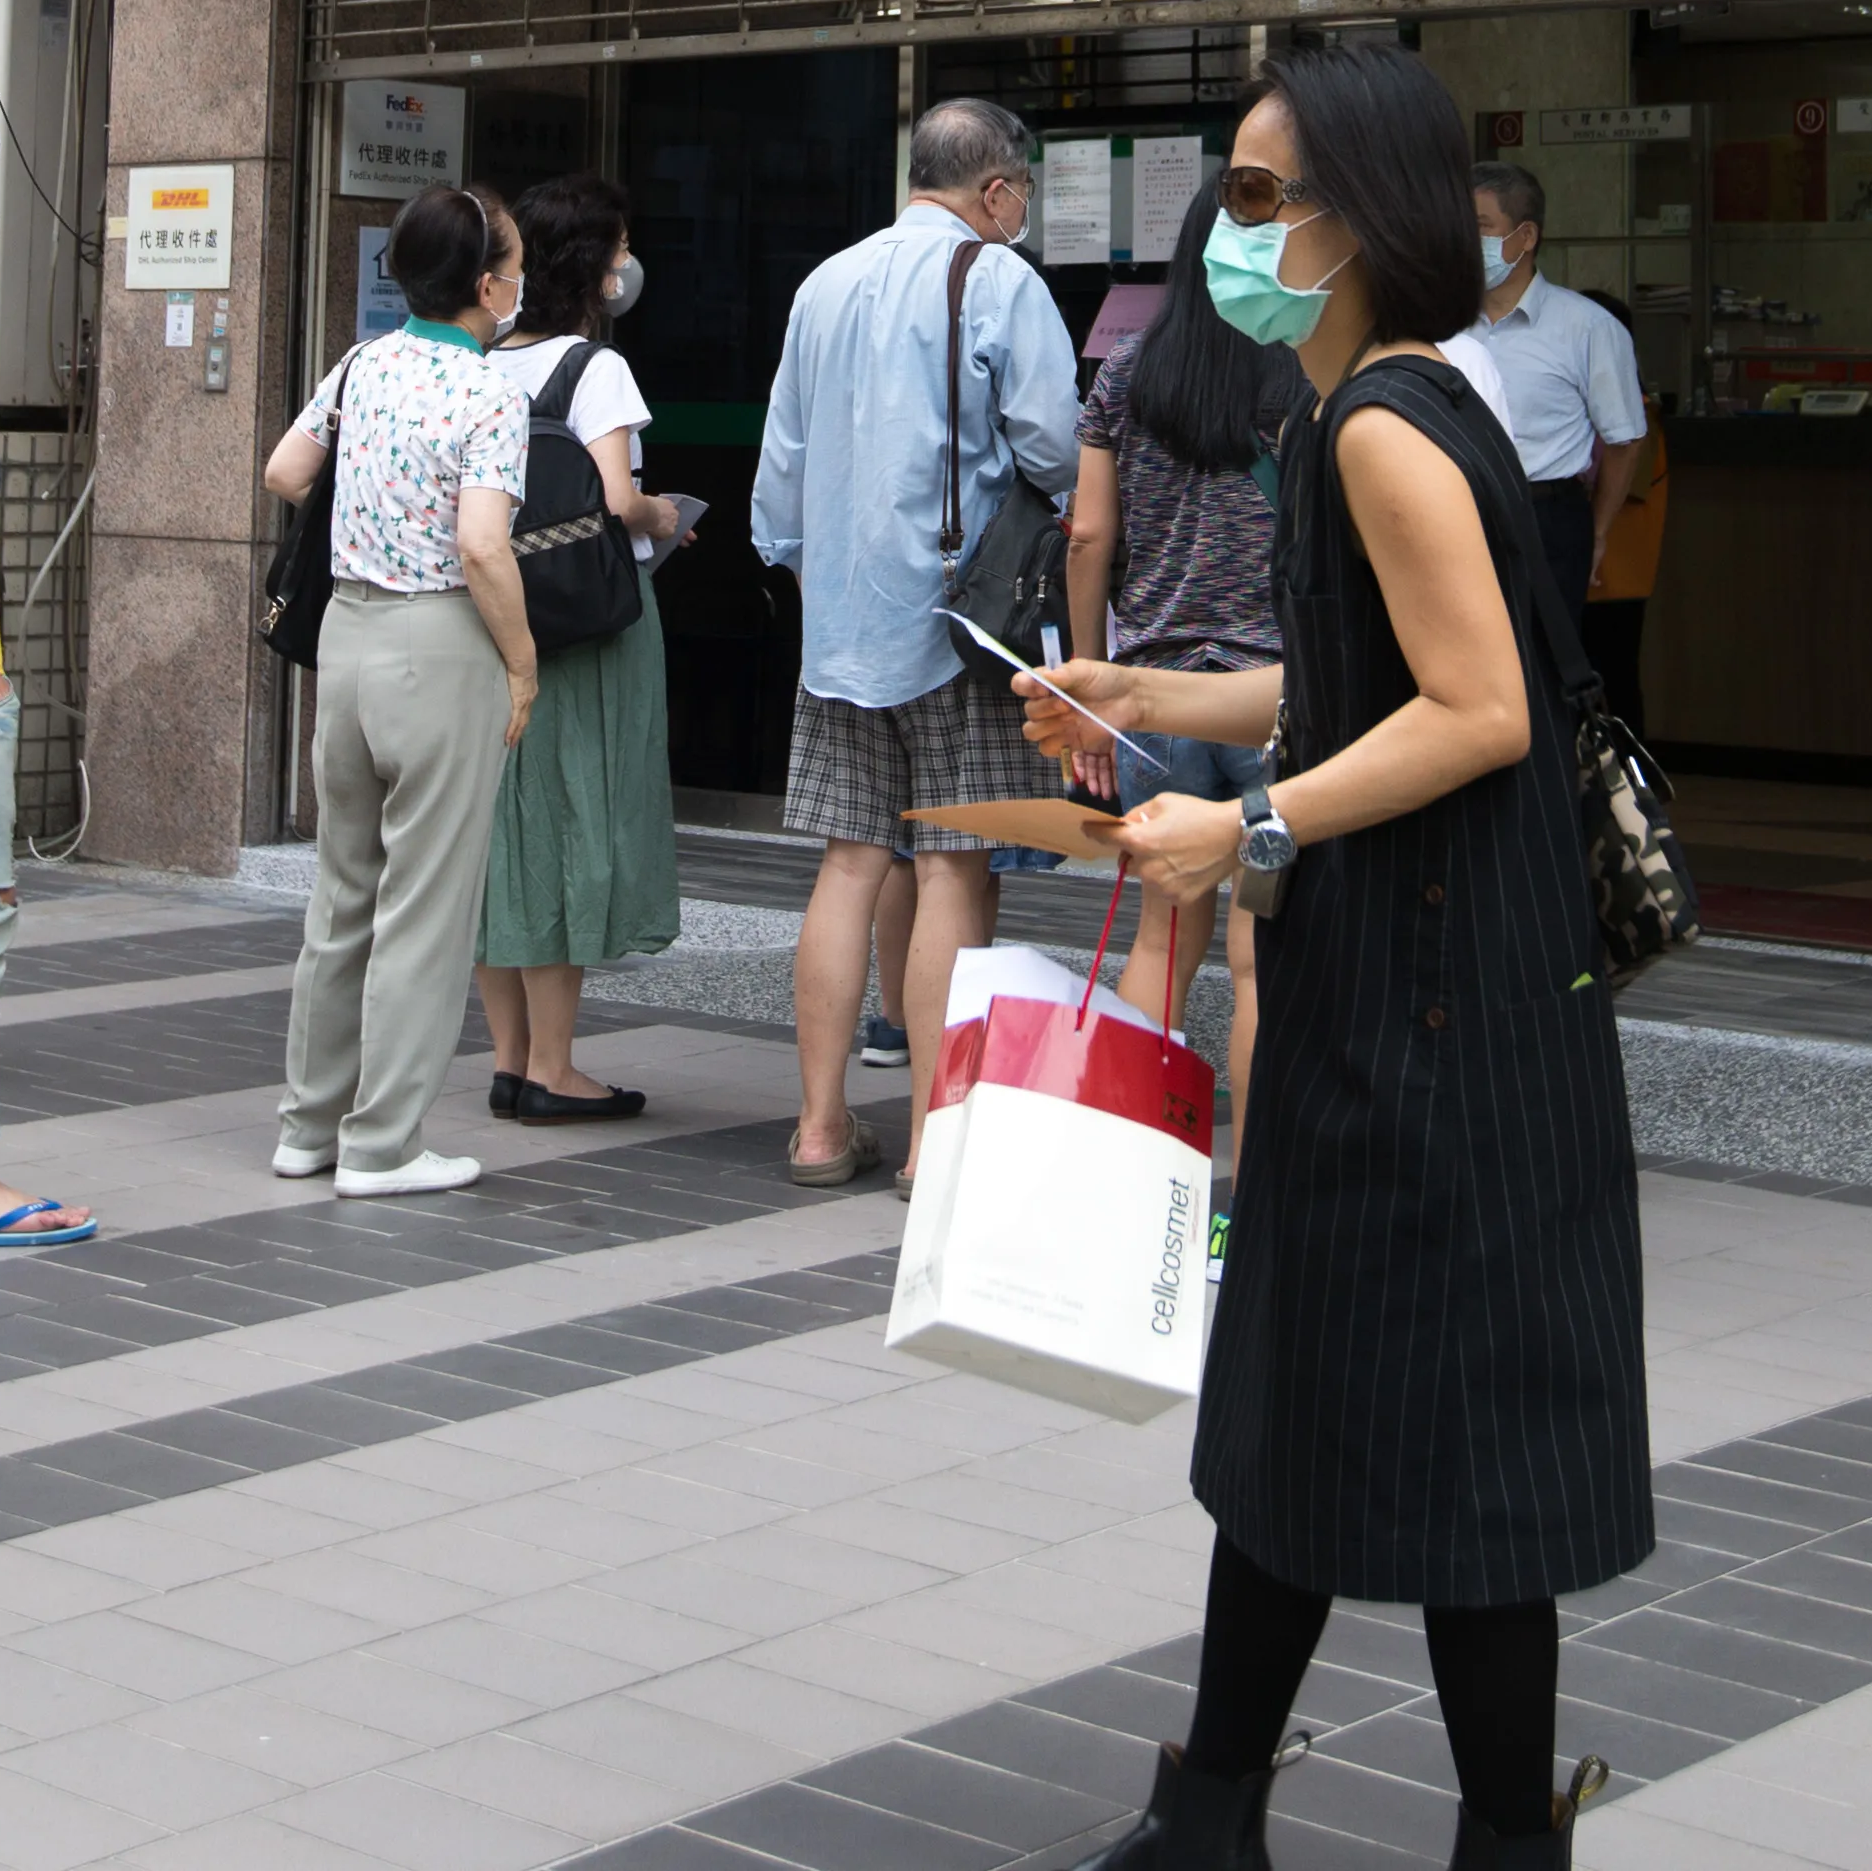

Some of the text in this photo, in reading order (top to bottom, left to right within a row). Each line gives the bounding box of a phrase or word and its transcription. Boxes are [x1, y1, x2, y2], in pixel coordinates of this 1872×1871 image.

[386, 94, 423, 113] FedEx
[1573, 127, 1659, 140] POSTAL SERVICES
[358, 143, 448, 169] 代理收件處
[349, 170, 371, 181] FedEx
[373, 172, 411, 184] Authorized
[413, 175, 428, 186] Ship
[161, 192, 201, 206] DHL
[139, 229, 218, 249] 代理收件處
[151, 256, 182, 264] Authorized
[184, 256, 196, 265] Ship
[198, 256, 218, 264] Center
[1151, 1175, 1190, 1336] cellcosmet
